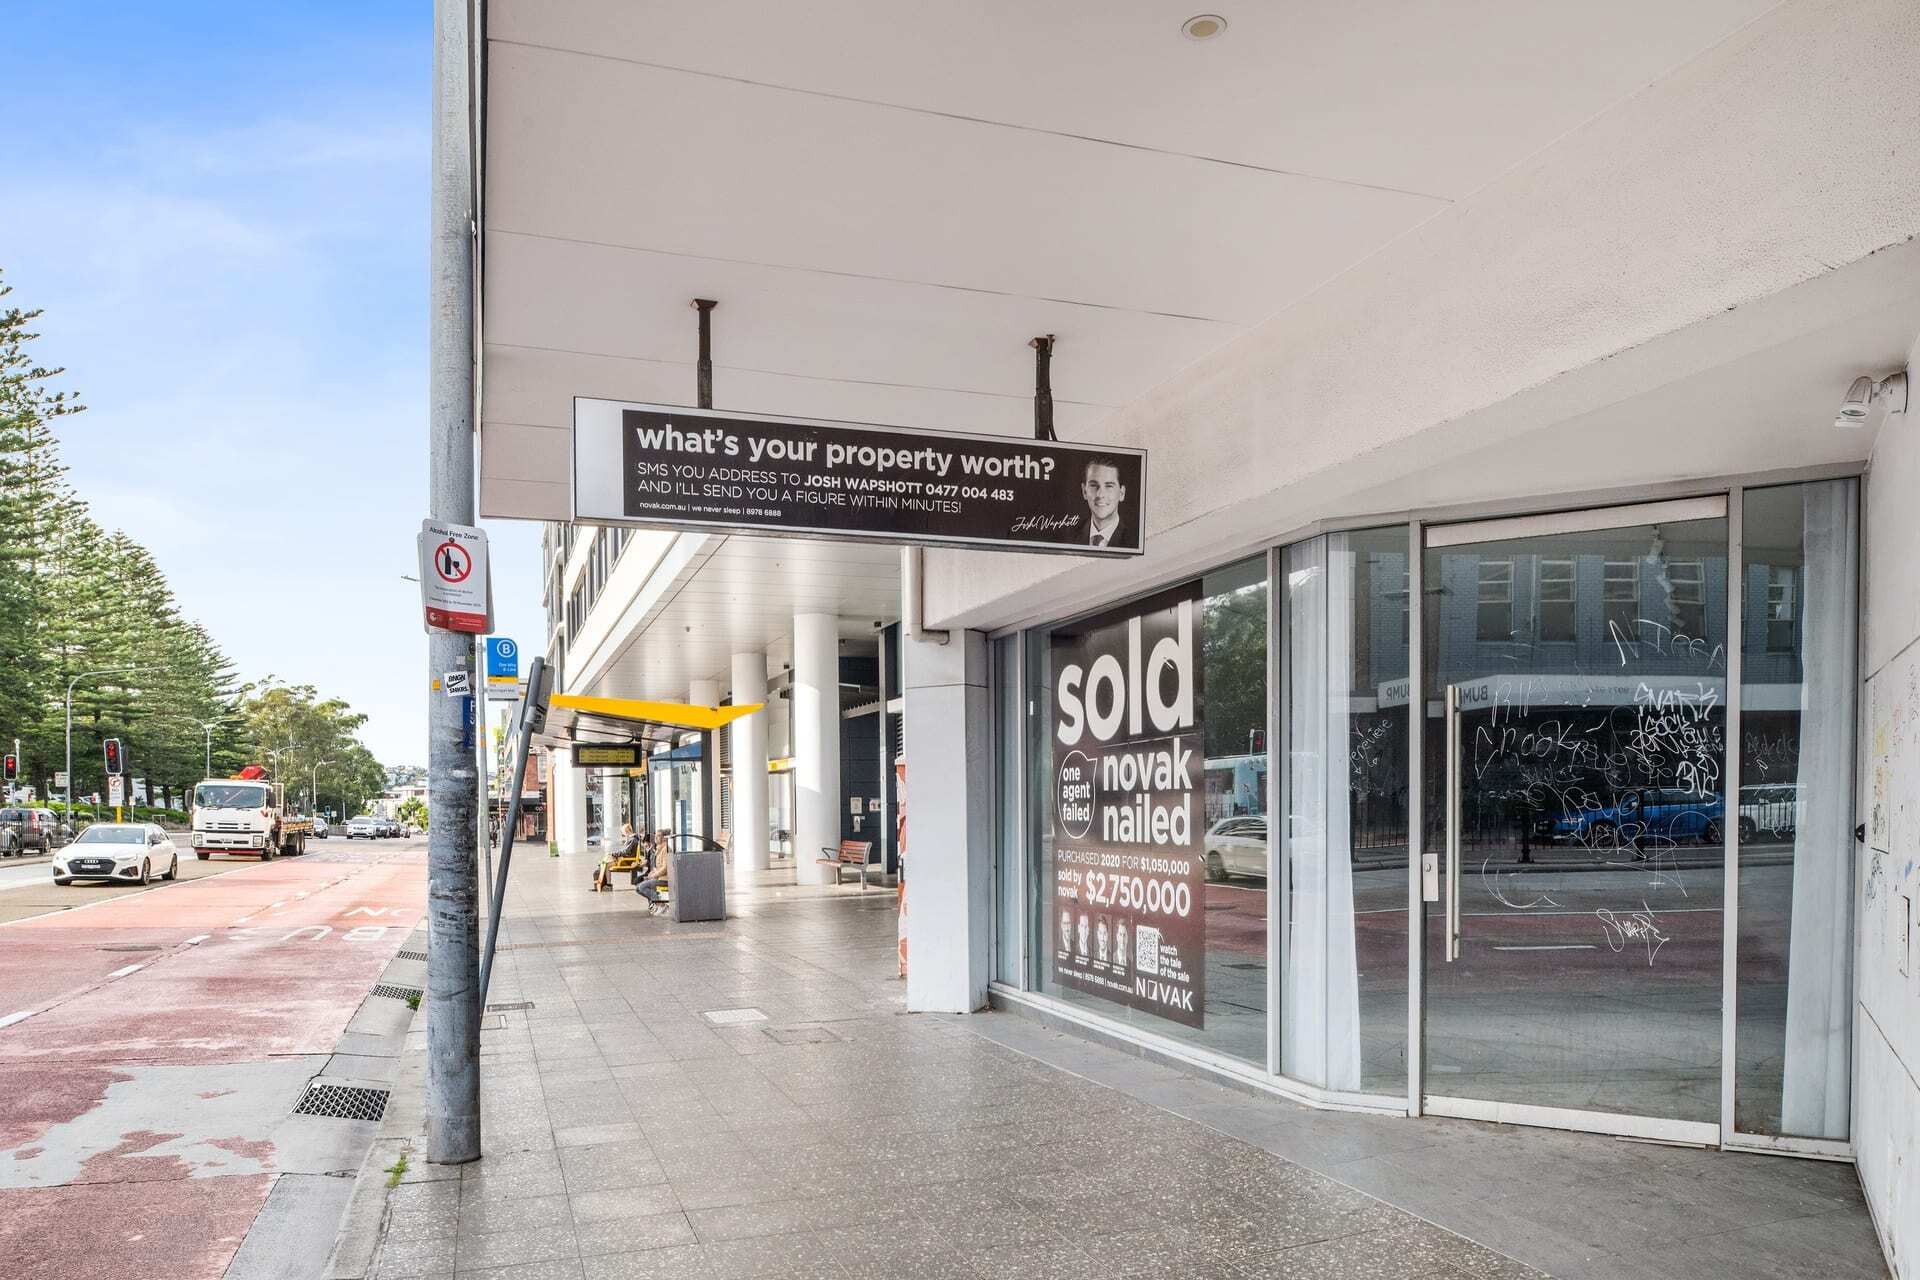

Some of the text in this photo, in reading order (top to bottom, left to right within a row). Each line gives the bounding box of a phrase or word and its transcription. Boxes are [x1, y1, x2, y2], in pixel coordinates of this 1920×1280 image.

[637, 424, 1055, 480] what's your property worth?
[638, 462, 1014, 501] SMS YOU ADDRESS TO JOSH WAPSHOTT 0477 004 483
[638, 480, 962, 513] AND I'LL SEND YOU A FIGURE WITHIN MINUTES!
[640, 501, 686, 511] novak.com.au
[723, 506, 741, 515] sleep
[449, 530, 463, 538] Free
[464, 532, 480, 540] Zone
[1057, 599, 1194, 746] sold
[1103, 737, 1192, 791] novak
[1063, 767, 1080, 781] one
[1063, 781, 1090, 802] agent
[1063, 803, 1090, 821] failed
[1103, 793, 1191, 845] nailed
[1057, 849, 1190, 876] PURCHASED 2020 FOR $1,050,000
[1058, 868, 1082, 885] sold by
[1058, 886, 1078, 898] novak
[1086, 869, 1191, 917] $2,750,000
[1160, 944, 1177, 956] watch
[1160, 954, 1181, 969] the tale
[1160, 966, 1190, 983] of the sale
